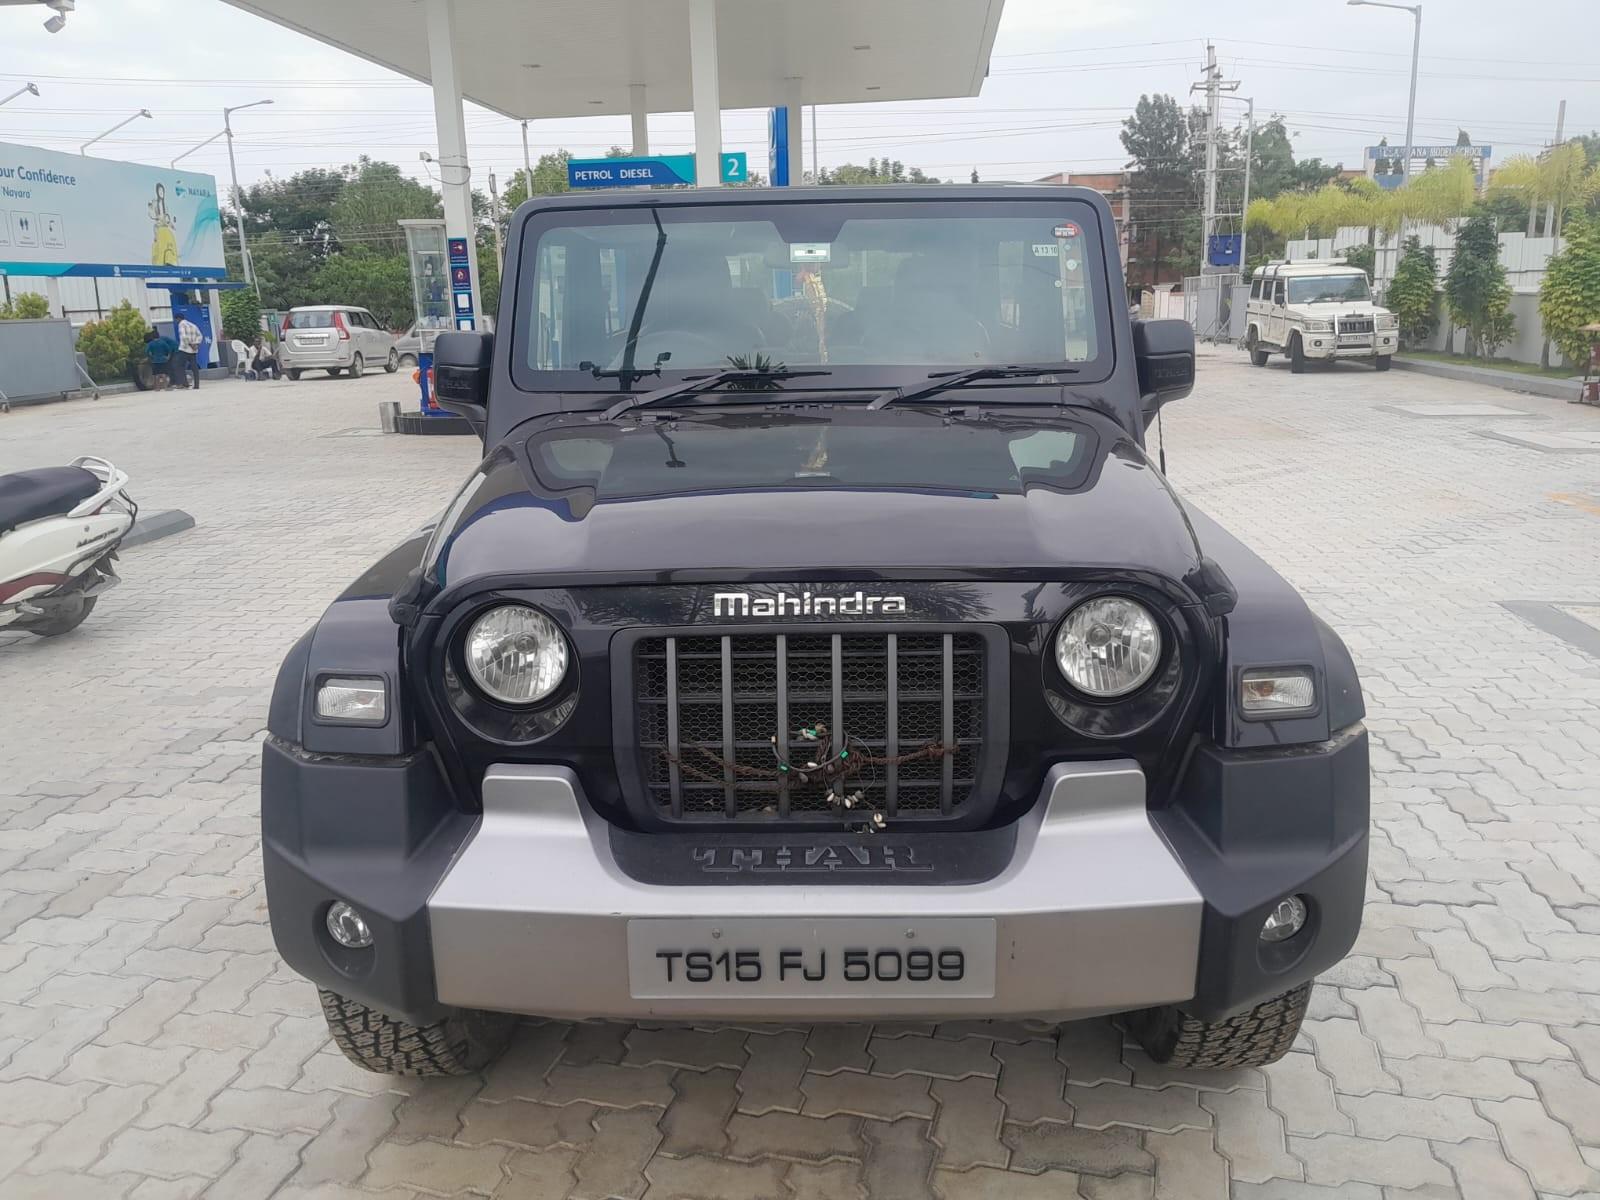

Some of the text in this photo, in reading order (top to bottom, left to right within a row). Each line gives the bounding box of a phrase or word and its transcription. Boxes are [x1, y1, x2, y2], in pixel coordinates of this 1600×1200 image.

[17, 165, 77, 186] Confidence
[575, 168, 654, 181] PETROL DIESEL
[727, 158, 740, 176] 2
[714, 591, 906, 616] Mahindra
[693, 845, 935, 872] THAR
[655, 951, 965, 983] TS15 FJ 5099
